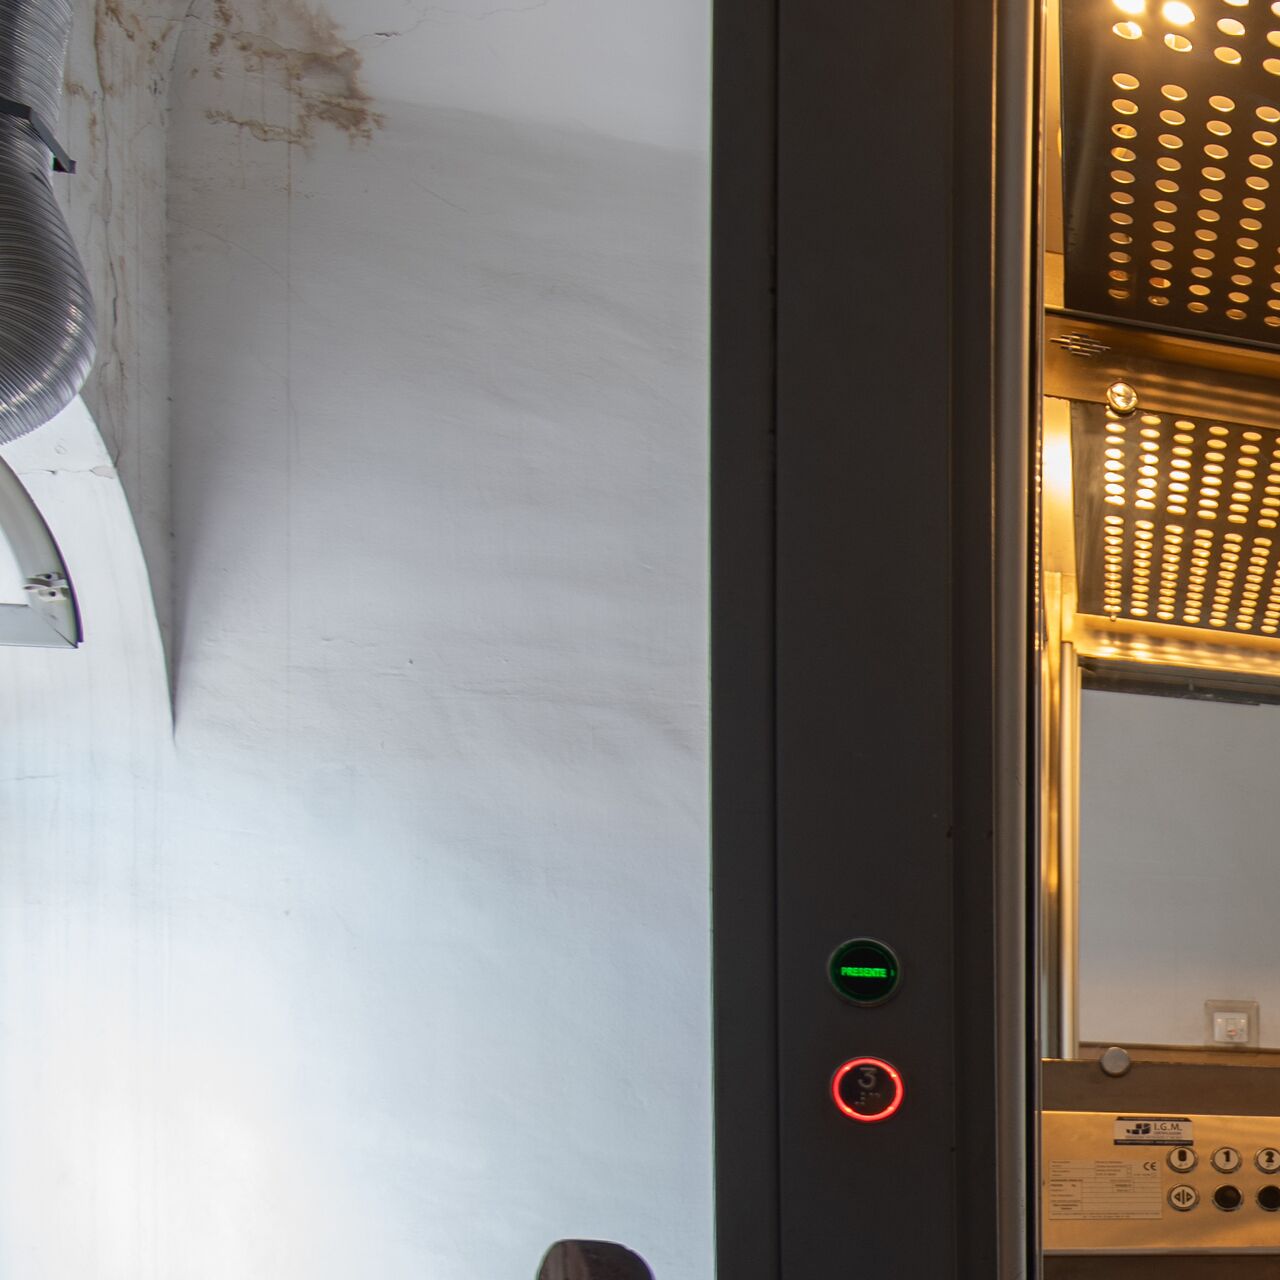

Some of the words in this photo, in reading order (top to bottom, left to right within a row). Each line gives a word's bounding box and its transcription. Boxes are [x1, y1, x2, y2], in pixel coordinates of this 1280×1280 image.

[841, 966, 888, 978] PRESENTE
[857, 1067, 877, 1089] 3
[1223, 1150, 1231, 1163] 1
[1265, 1151, 1275, 1164] 2
